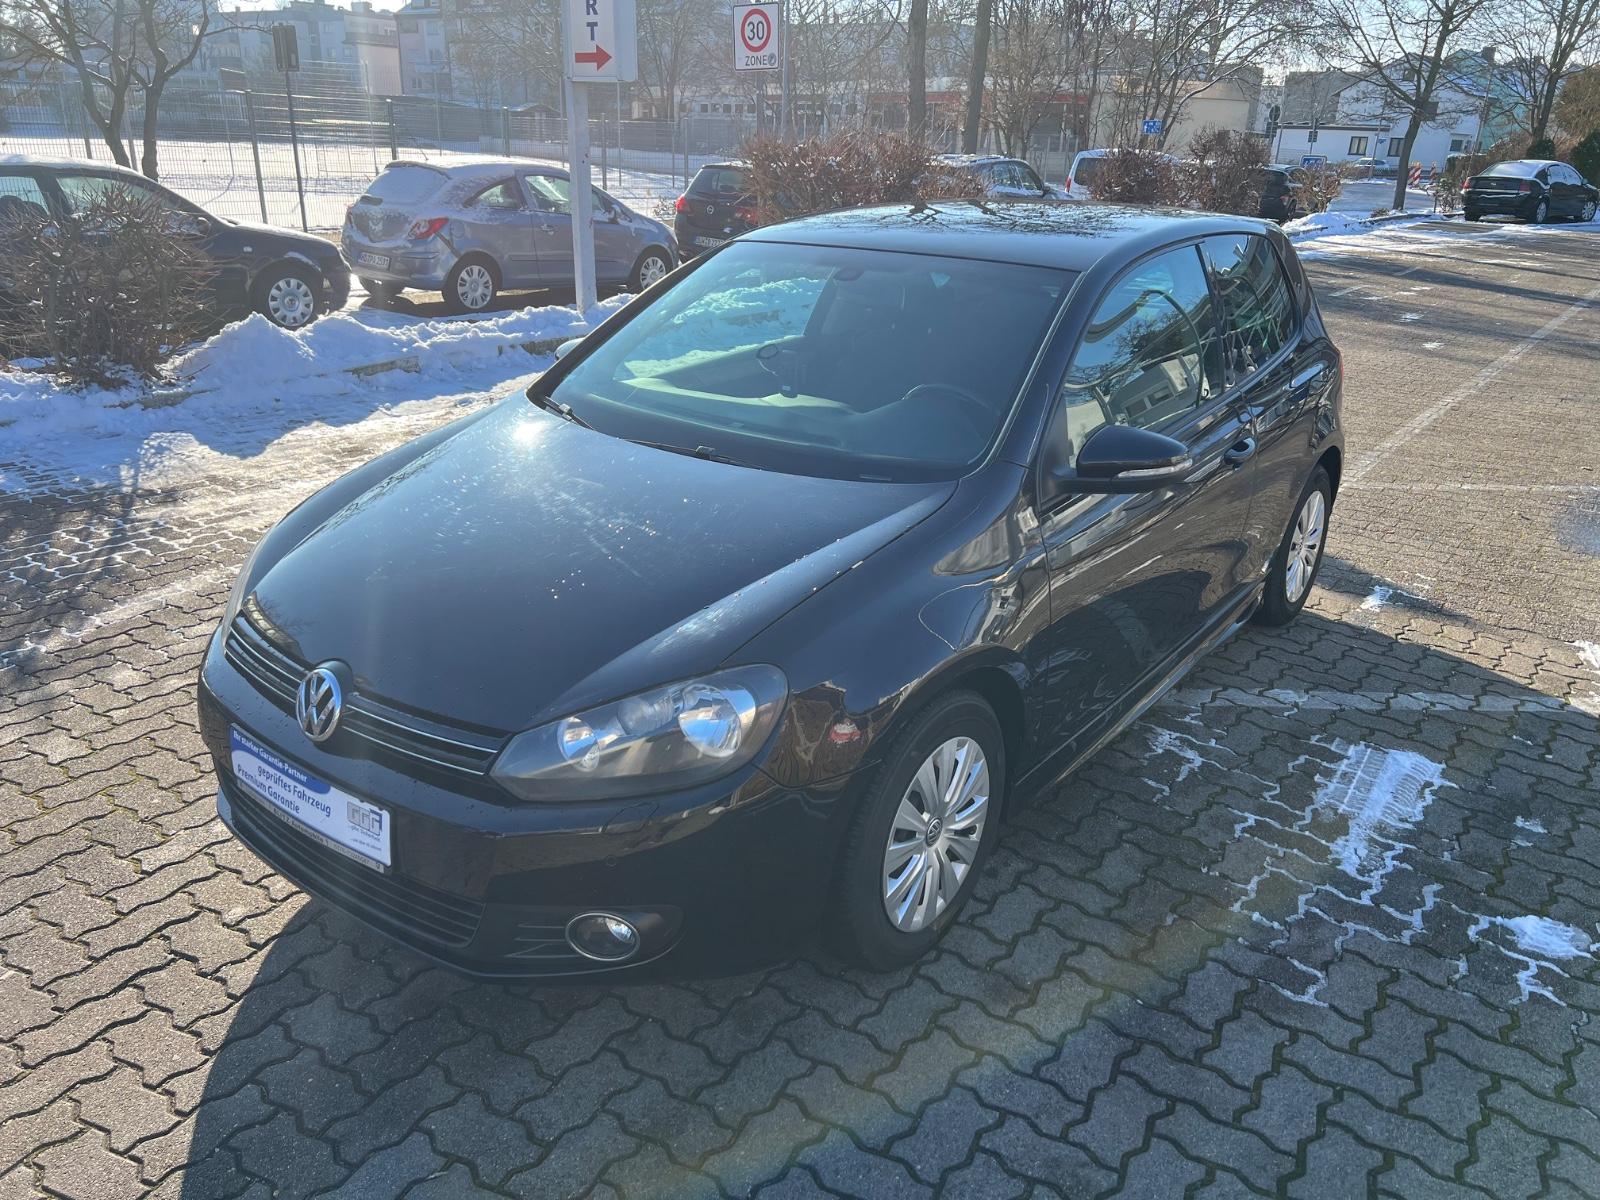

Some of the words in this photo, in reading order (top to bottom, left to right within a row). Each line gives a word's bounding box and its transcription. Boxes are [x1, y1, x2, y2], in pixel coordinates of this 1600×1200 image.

[747, 21, 765, 41] 30
[745, 55, 768, 67] ZONE
[259, 748, 308, 783] Garantie-Partner
[237, 763, 267, 793] Premium
[267, 786, 301, 814] Garantie
[257, 765, 292, 794] geprüftes
[292, 784, 332, 818] Fahrzeug
